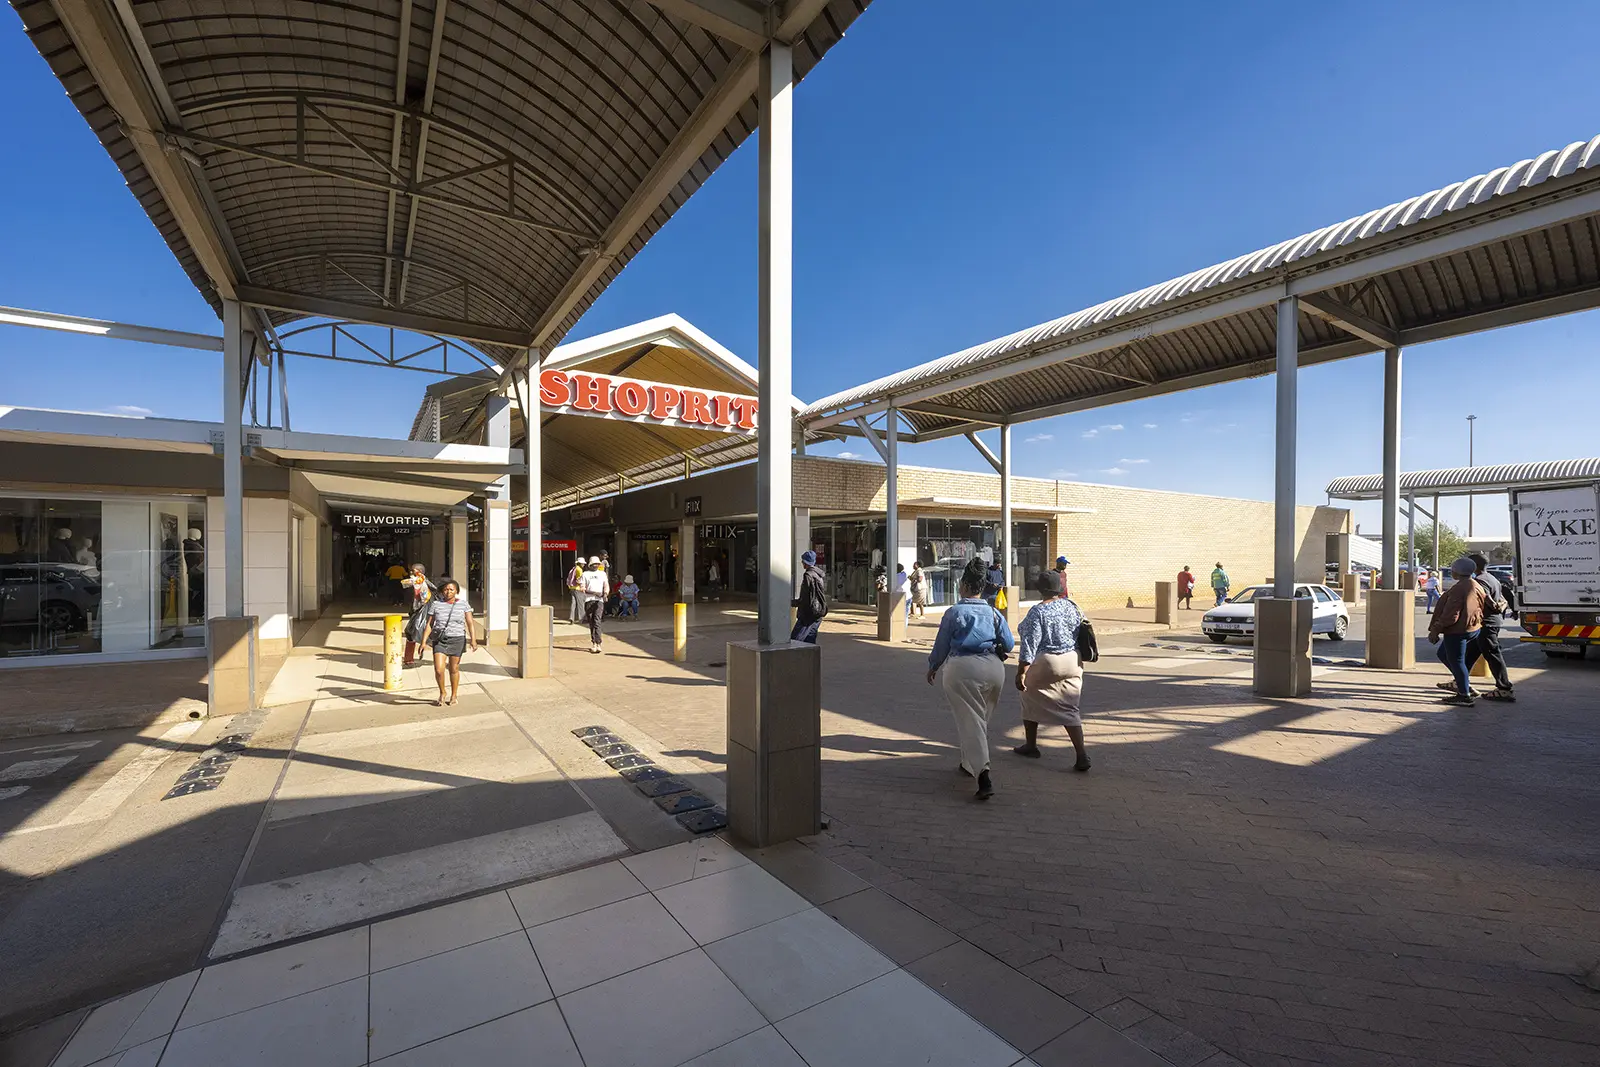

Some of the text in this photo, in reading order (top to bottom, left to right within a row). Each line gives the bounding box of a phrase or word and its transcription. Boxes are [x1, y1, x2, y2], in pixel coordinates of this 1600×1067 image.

[540, 368, 759, 430] SHOPRIT
[344, 514, 430, 526] TRUWORTHS
[1547, 509, 1568, 519] you
[1523, 518, 1597, 538] CAKE
[1553, 538, 1572, 546] We
